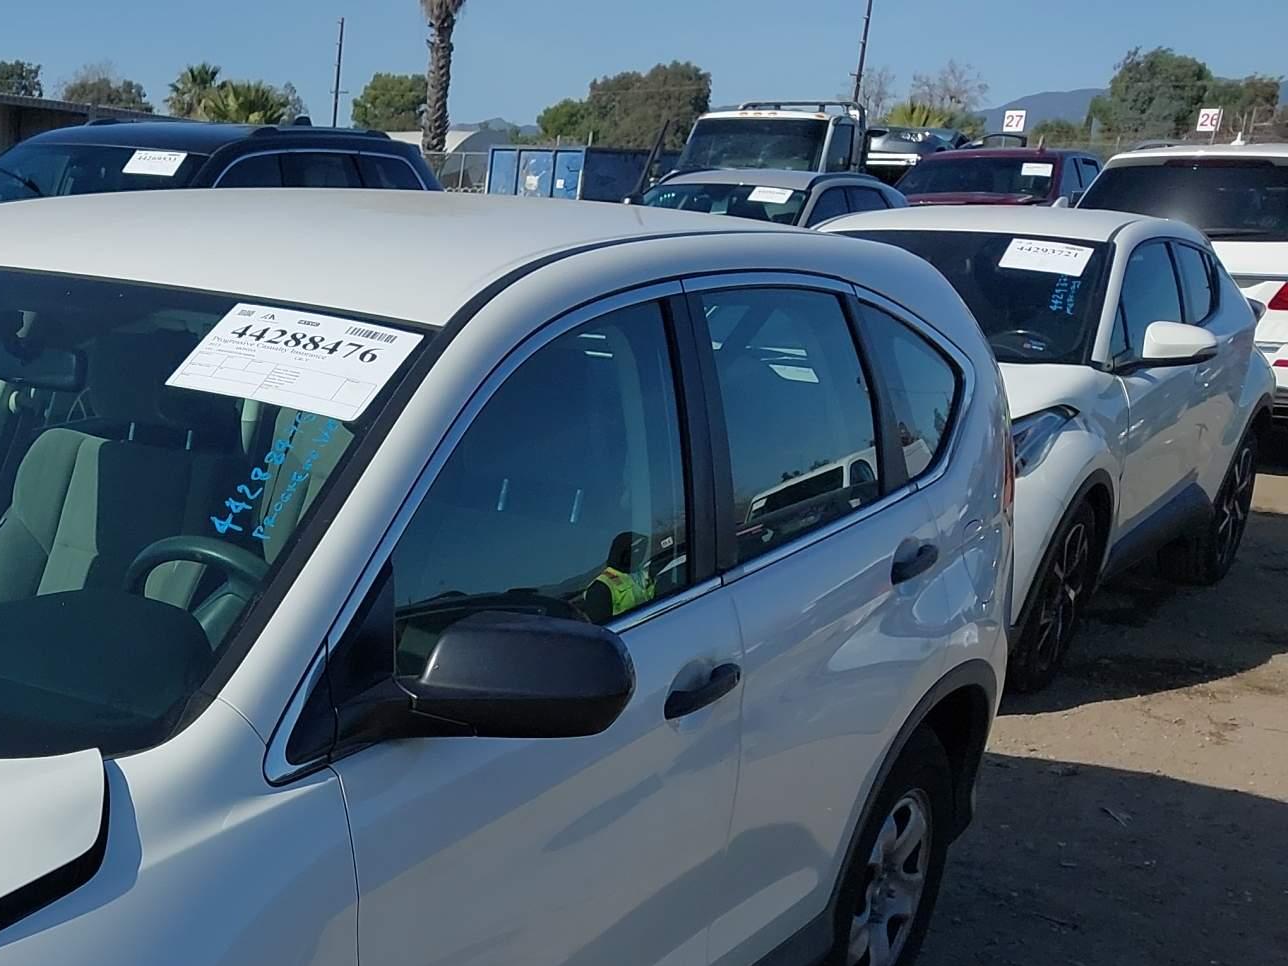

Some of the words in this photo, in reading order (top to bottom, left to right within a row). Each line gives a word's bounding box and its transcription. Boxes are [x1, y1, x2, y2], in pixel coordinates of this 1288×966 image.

[1004, 114, 1024, 128] 27
[1199, 112, 1219, 127] 26
[1016, 245, 1079, 259] 44293721
[212, 335, 256, 348] Progressive
[256, 341, 289, 354] Casualty
[289, 347, 328, 361] Insurance
[230, 324, 385, 364] 44288476
